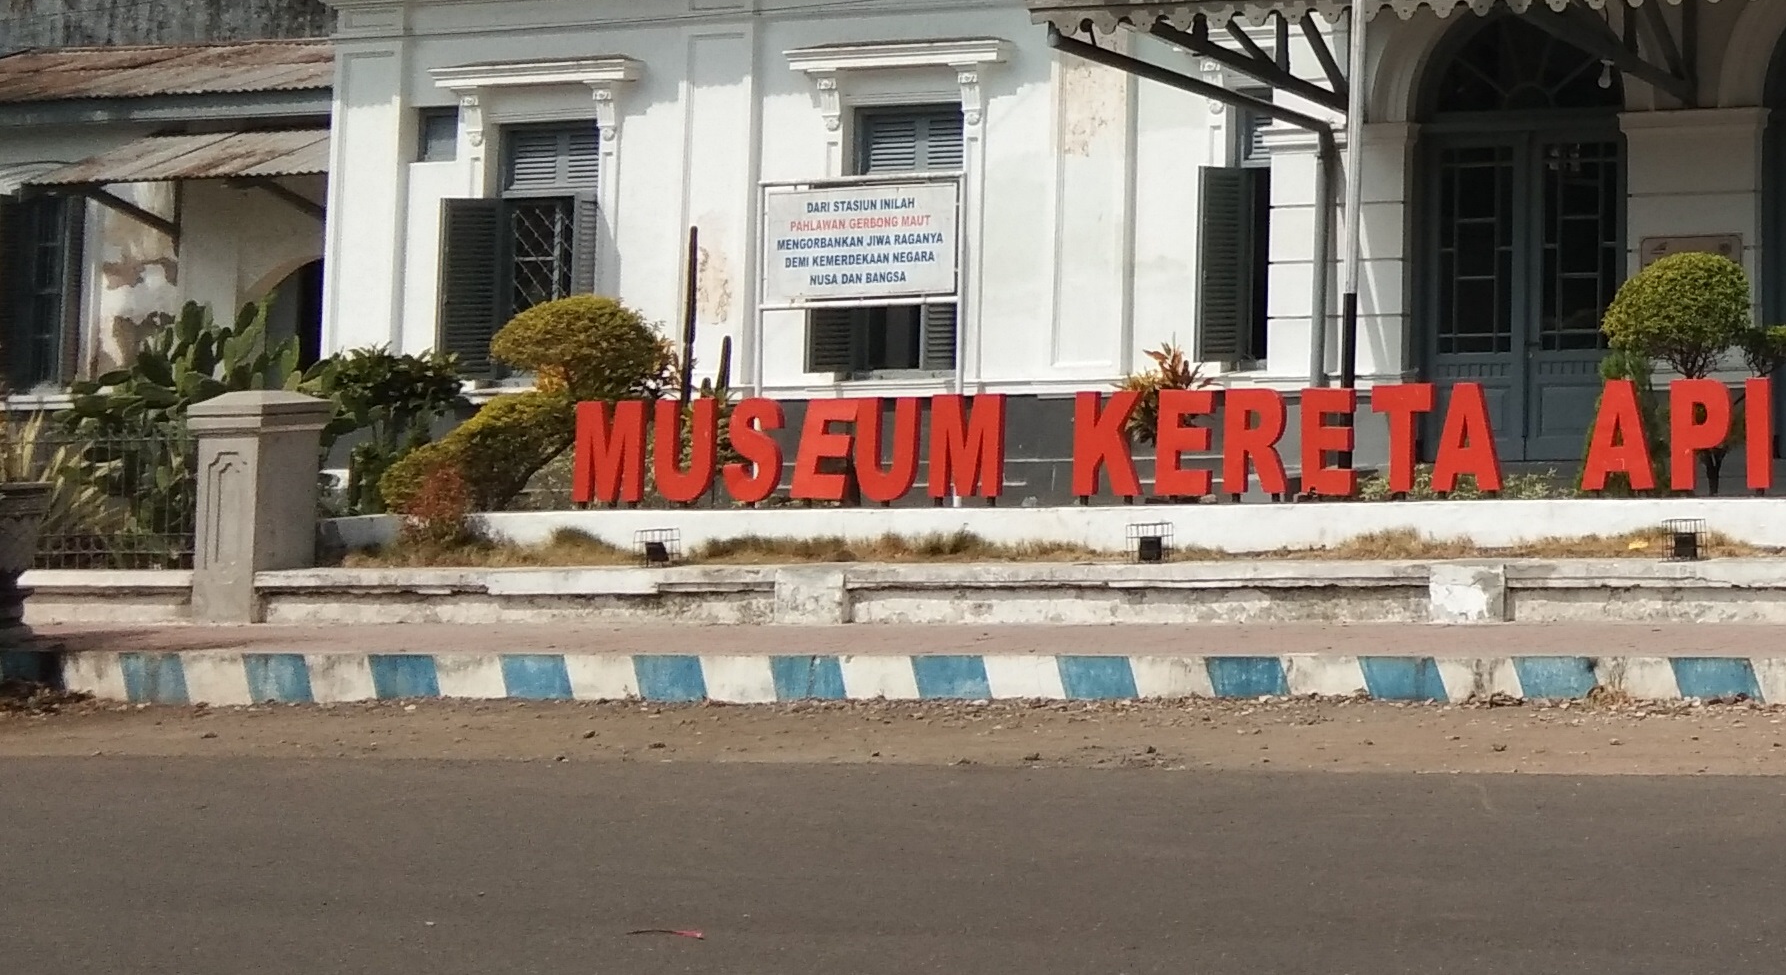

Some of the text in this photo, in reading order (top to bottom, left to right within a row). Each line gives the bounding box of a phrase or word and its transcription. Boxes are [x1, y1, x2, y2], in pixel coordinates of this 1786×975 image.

[807, 197, 915, 214] DARI STASIUN INILAH
[790, 214, 931, 232] PAHLAWAN GERBONG MAUT
[777, 232, 943, 251] MENGORBANKAN JIWA RAGANYA
[785, 251, 935, 268] DEMI KEMERDEKAAN NEGARA
[809, 271, 907, 286] NUSA DAN BANGSA
[571, 393, 1006, 503] MUSEUM
[1072, 382, 1503, 497] KERETA
[1580, 378, 1772, 491] API
